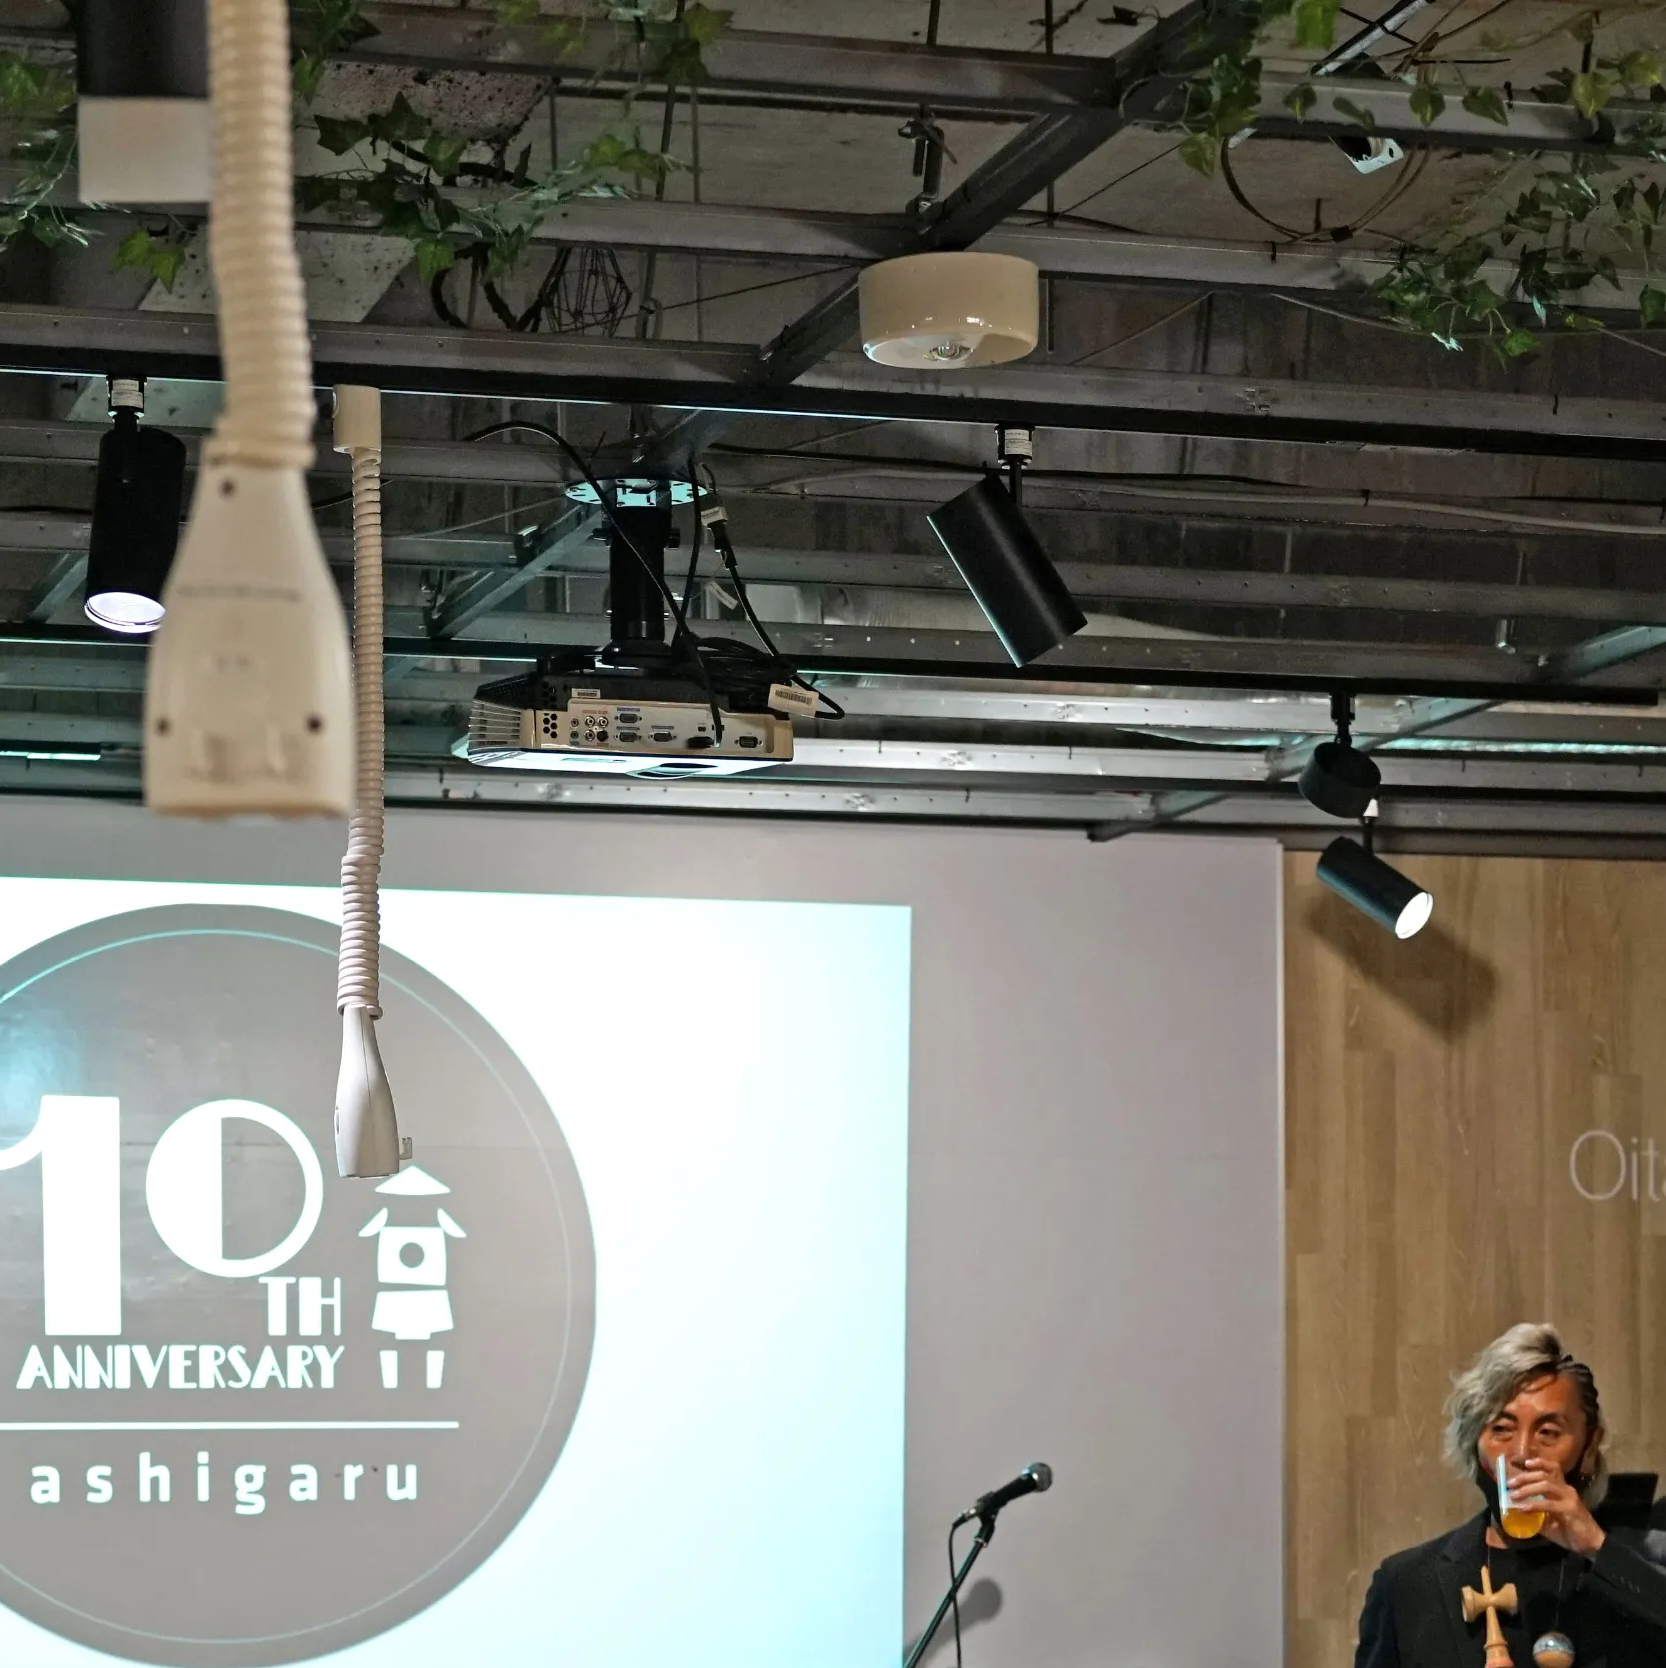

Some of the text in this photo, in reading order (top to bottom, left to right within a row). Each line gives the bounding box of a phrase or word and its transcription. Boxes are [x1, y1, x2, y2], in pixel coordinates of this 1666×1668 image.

[259, 1277, 341, 1336] TH
[15, 1344, 346, 1390] ANNIVERSARY
[30, 1451, 419, 1515] ashigaru
